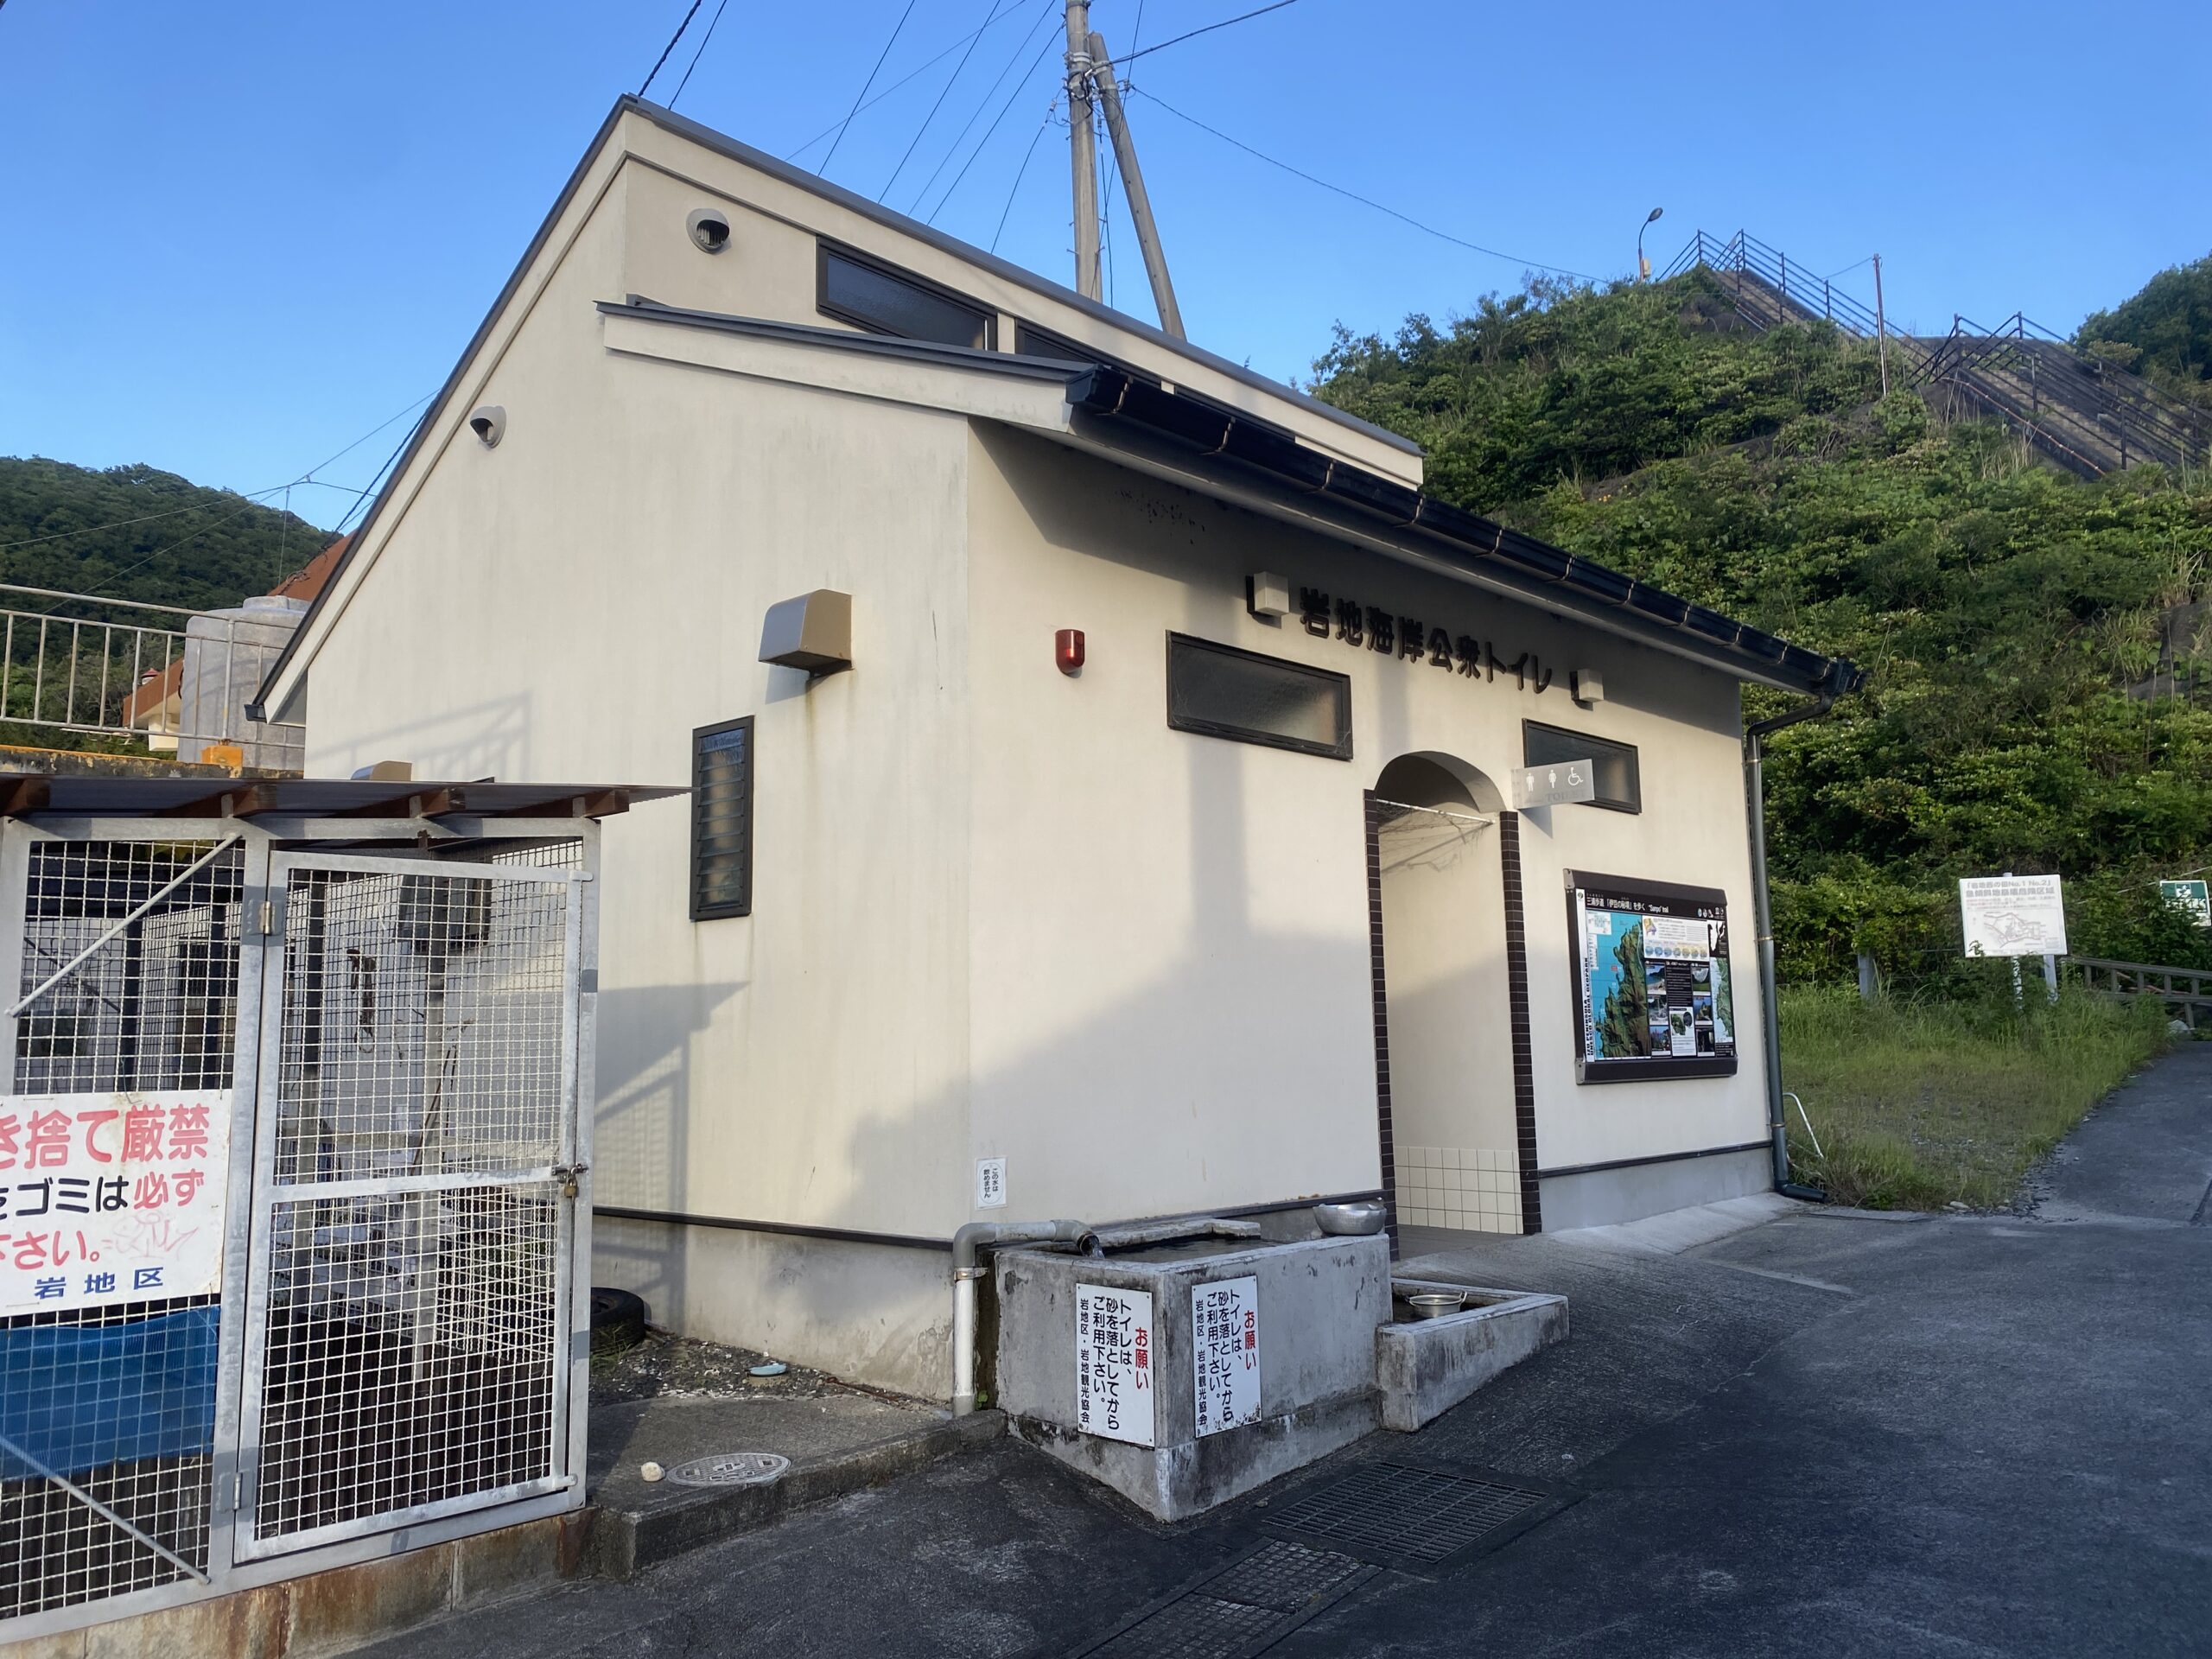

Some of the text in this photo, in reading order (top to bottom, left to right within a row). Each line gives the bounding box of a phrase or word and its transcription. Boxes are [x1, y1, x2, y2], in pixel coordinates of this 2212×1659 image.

[1300, 587, 1552, 695] 岩地海岸公衆トイレ
[35, 1267, 163, 1300] 岩地区
[1230, 1289, 1243, 1360] トイレは、
[1093, 1296, 1106, 1403] ご利用下さい。
[1106, 1298, 1120, 1430] 砂を落としてから
[1120, 1299, 1132, 1375] トイレは、
[1135, 1326, 1149, 1389] お願い
[1207, 1292, 1221, 1398] ご利用下さい。
[1217, 1291, 1234, 1421] 砂を落としてから
[1244, 1310, 1256, 1370] お願い
